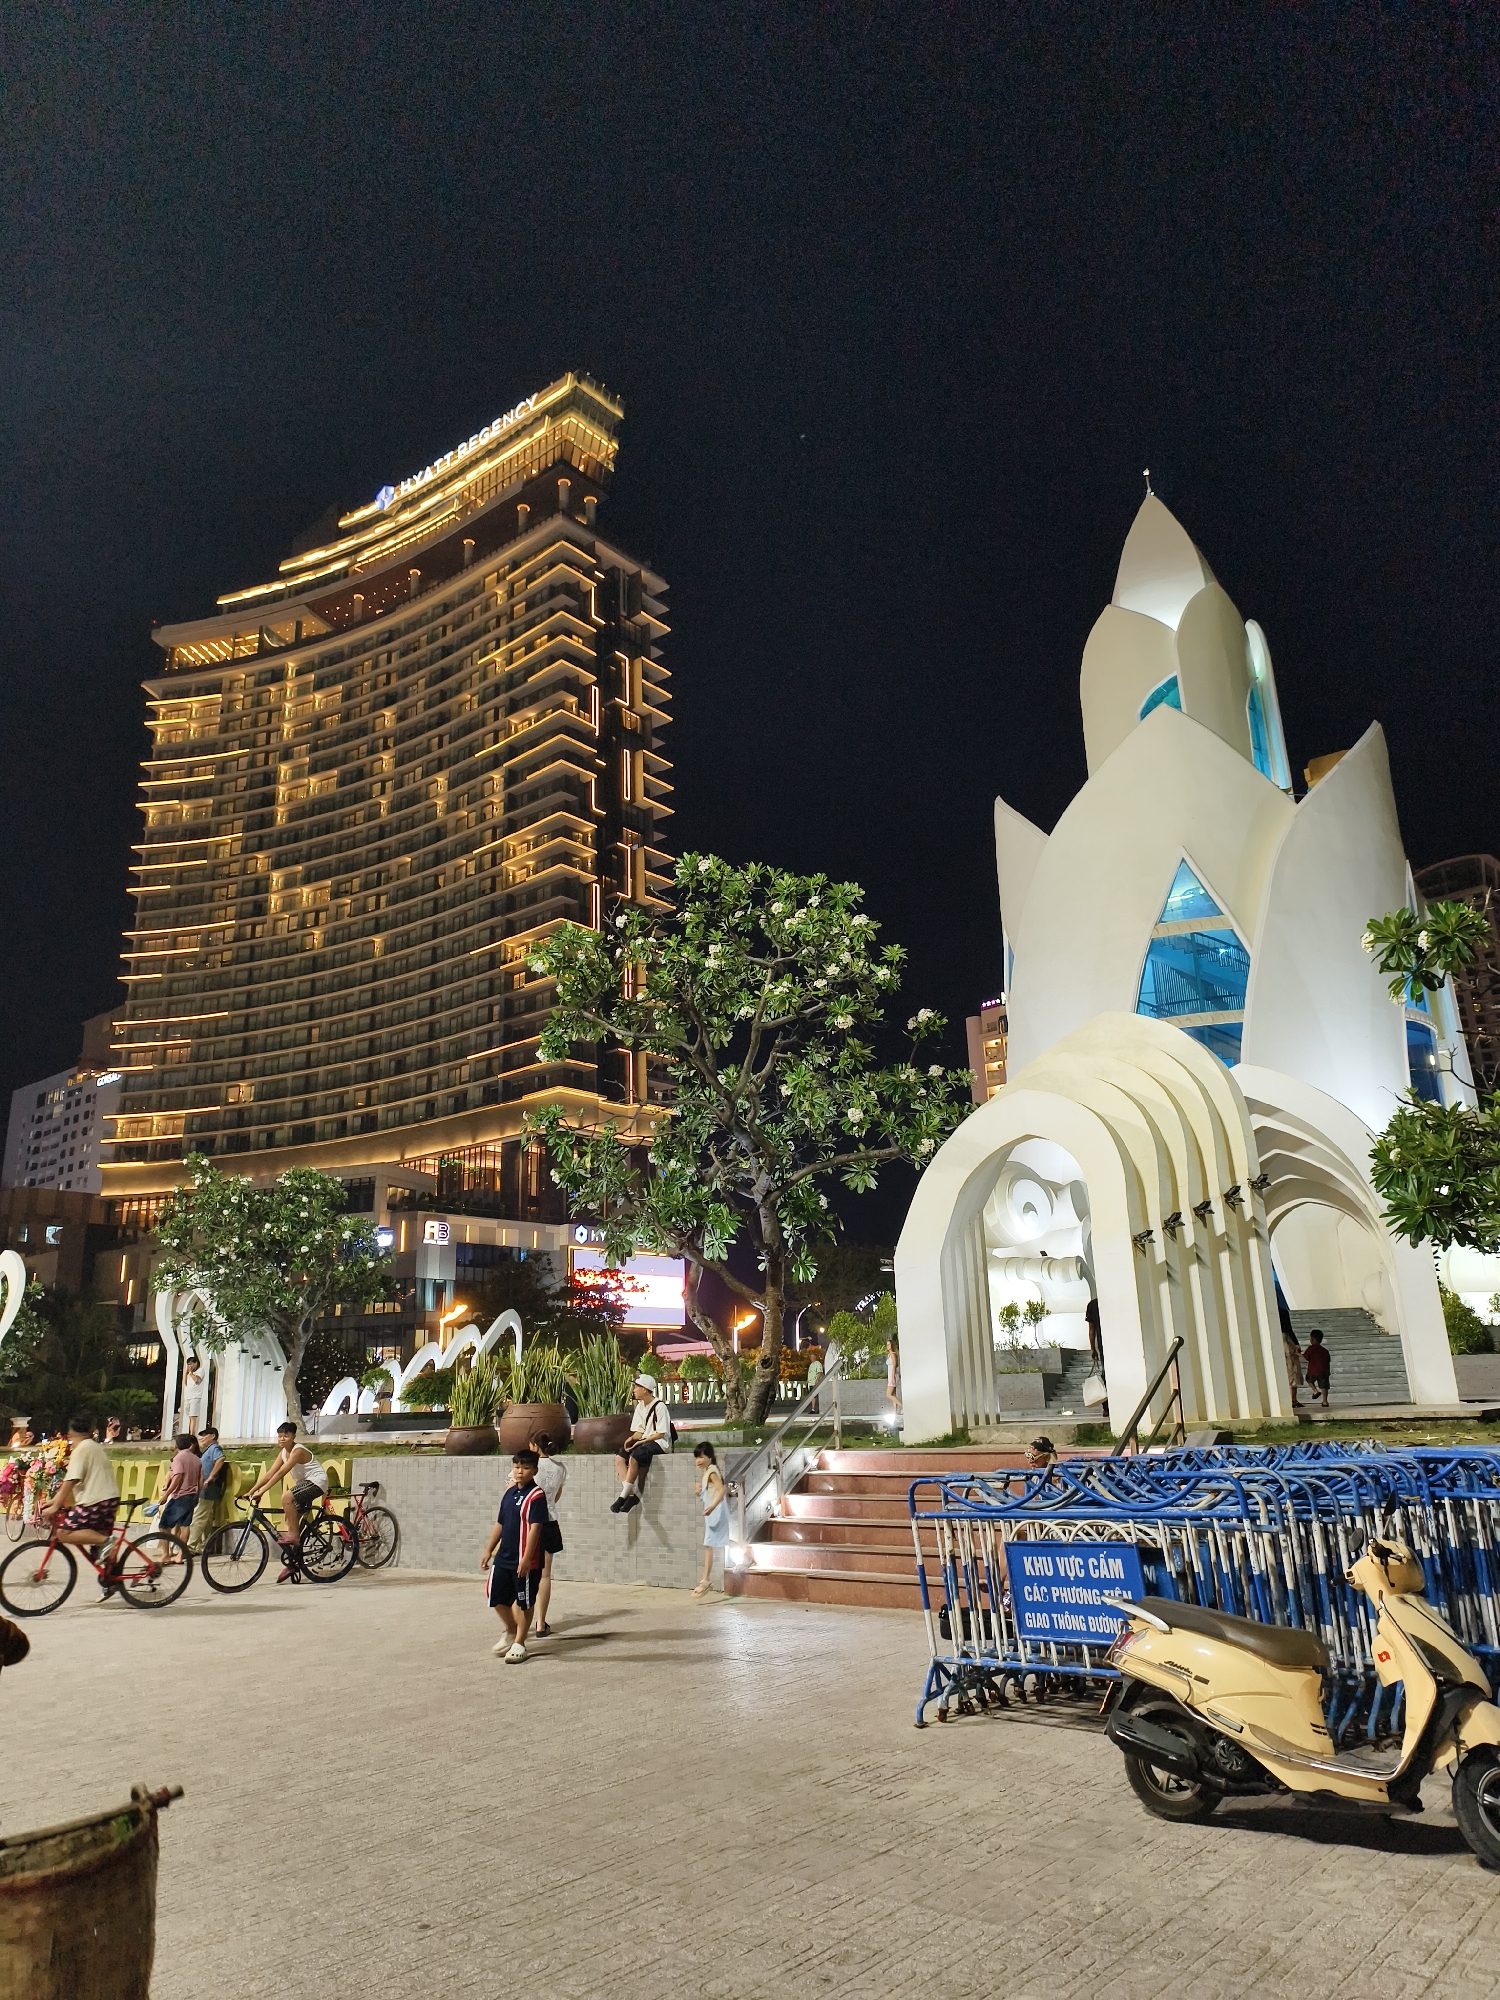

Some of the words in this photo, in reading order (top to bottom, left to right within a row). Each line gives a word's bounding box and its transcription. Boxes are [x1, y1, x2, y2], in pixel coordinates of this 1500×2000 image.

[400, 450, 455, 495] HYATT
[457, 392, 539, 460] REGENCY
[1023, 1556, 1054, 1577] KHU
[1056, 1555, 1085, 1581] VỰC
[1088, 1551, 1125, 1579] CẤM
[1023, 1583, 1049, 1603] CÁC
[1051, 1586, 1102, 1605] PHƯƠNG
[1024, 1612, 1050, 1629] GIAO
[1051, 1611, 1087, 1632] THÔNG
